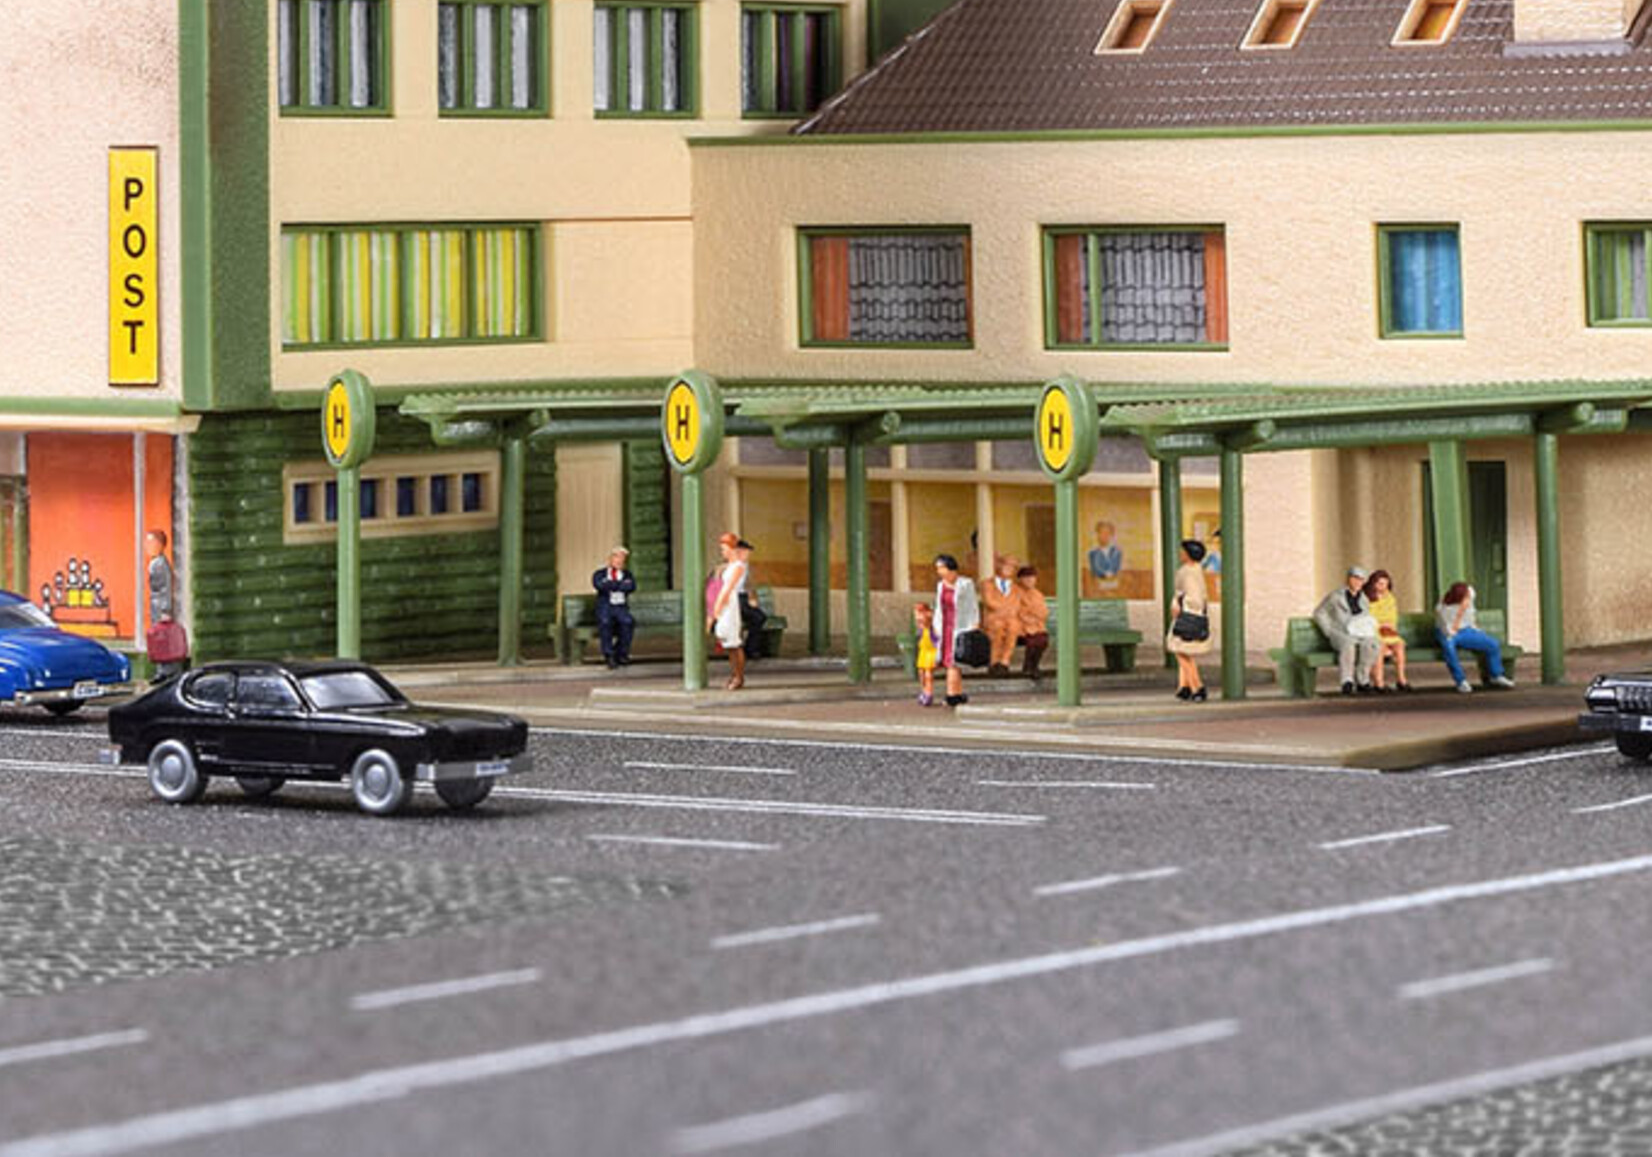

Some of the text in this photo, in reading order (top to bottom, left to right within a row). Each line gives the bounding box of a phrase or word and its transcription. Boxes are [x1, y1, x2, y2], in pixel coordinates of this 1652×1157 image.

[122, 177, 146, 354] POST
[333, 404, 345, 439] H
[675, 405, 690, 441] H
[1048, 411, 1063, 450] H
